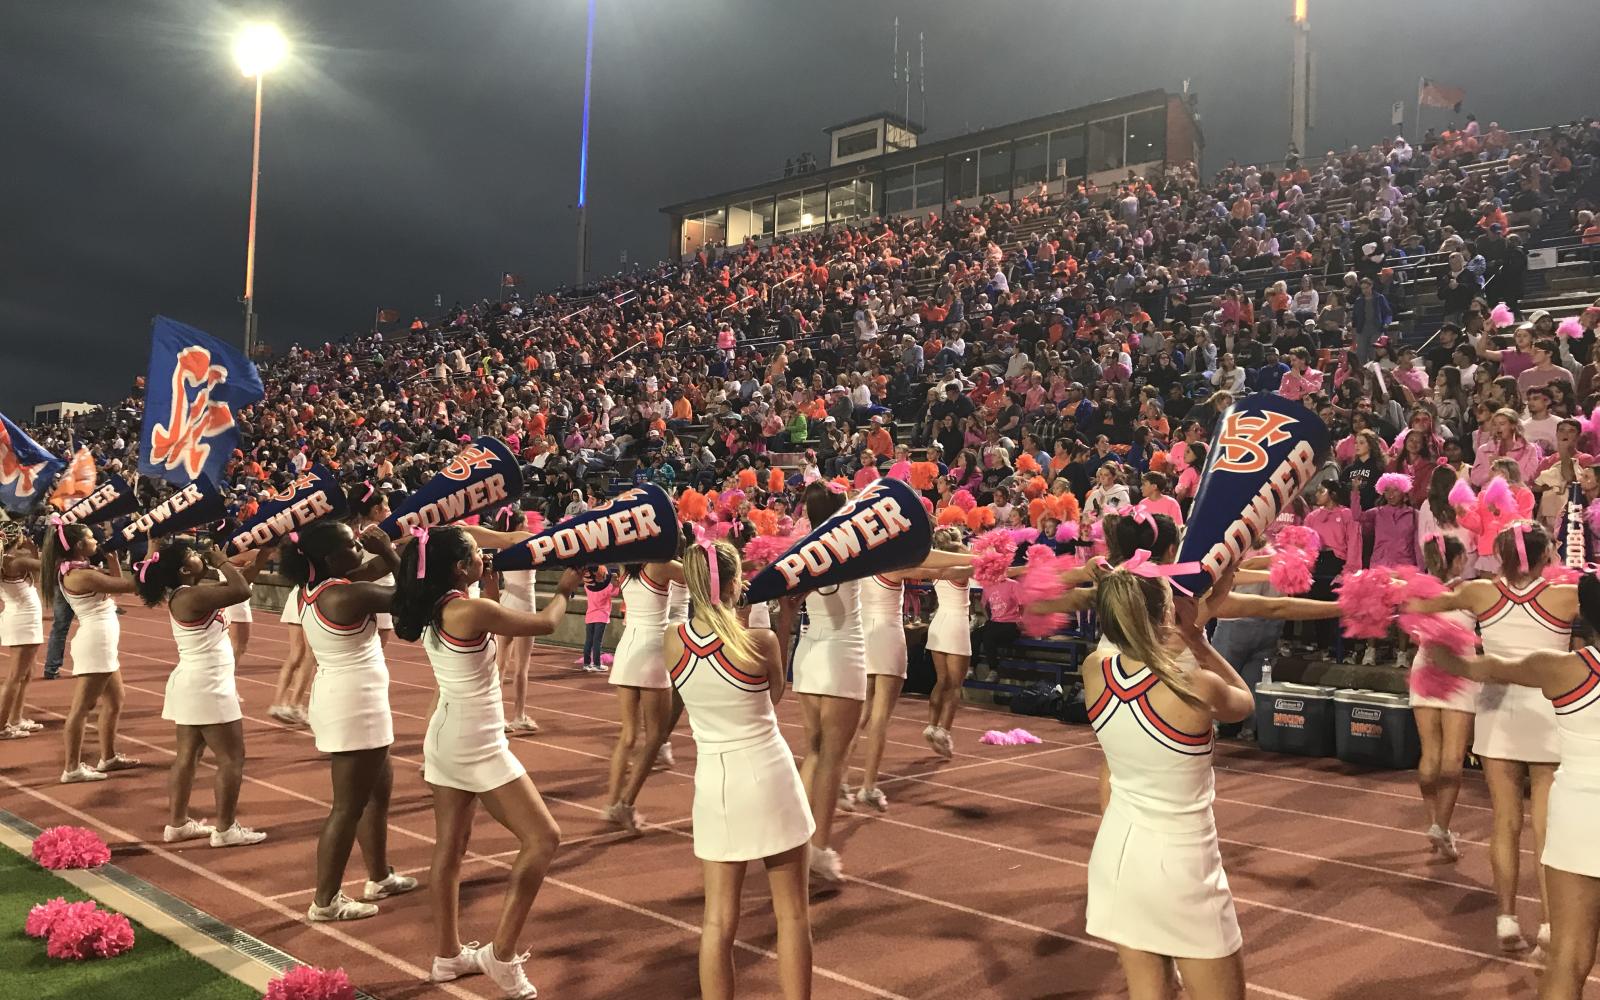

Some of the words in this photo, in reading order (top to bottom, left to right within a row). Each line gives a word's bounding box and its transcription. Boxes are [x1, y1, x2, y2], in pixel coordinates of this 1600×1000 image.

[61, 484, 120, 524] OWER
[396, 473, 508, 537] POWER
[1349, 469, 1371, 478] TEXAS
[122, 483, 204, 541] POWER
[232, 490, 334, 552] POWER
[526, 503, 661, 566] POWER
[775, 496, 912, 590] POWER
[1201, 440, 1317, 583] POWER
[1566, 501, 1585, 568] BOBCAT
